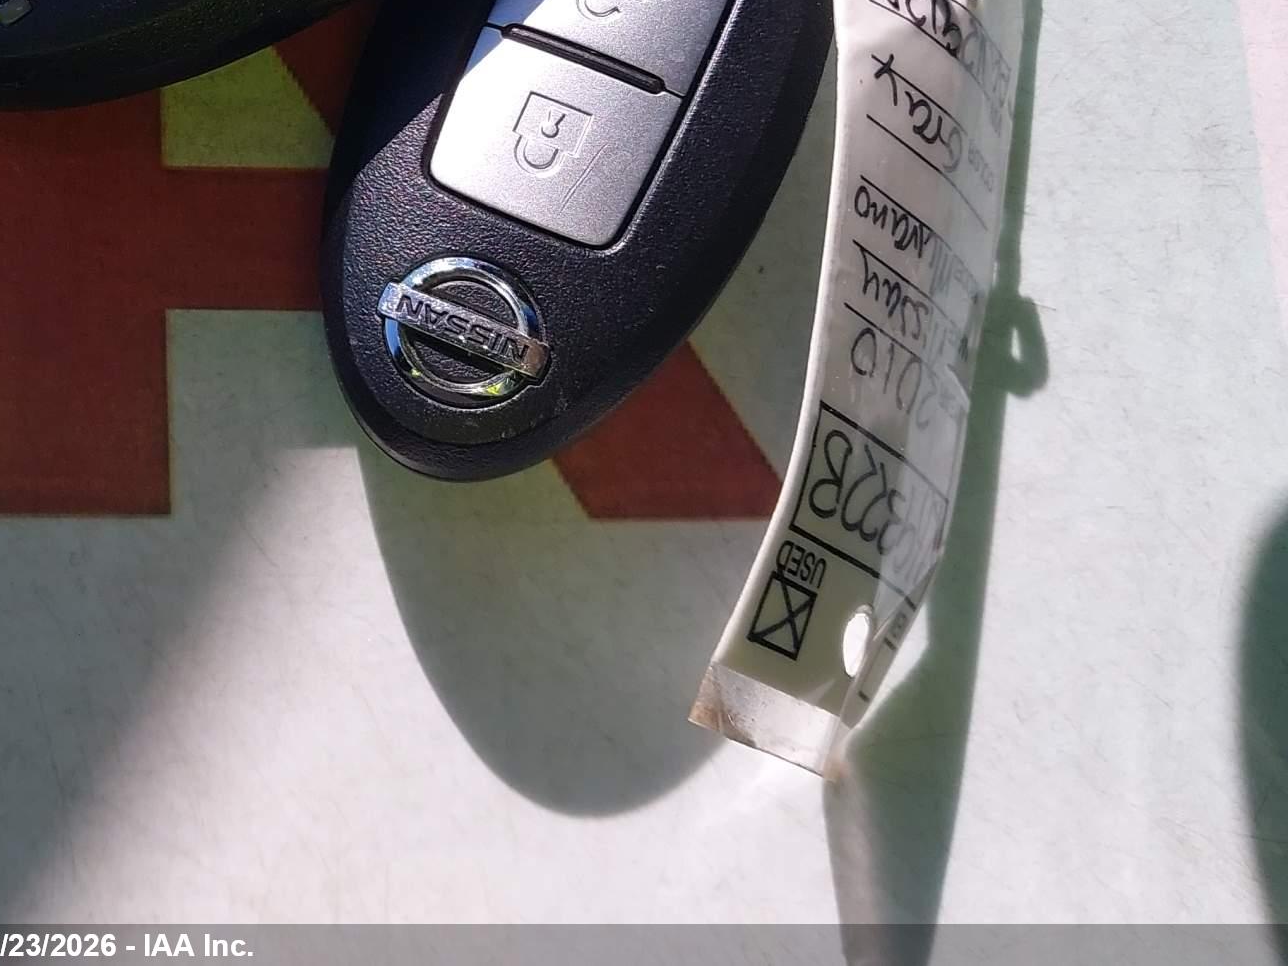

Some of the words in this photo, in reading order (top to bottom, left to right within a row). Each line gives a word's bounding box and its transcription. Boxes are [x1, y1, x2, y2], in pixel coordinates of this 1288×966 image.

[870, 52, 964, 175] Gray
[395, 294, 529, 367] NISSAN
[851, 327, 937, 431] 2010
[775, 539, 827, 590] USED
